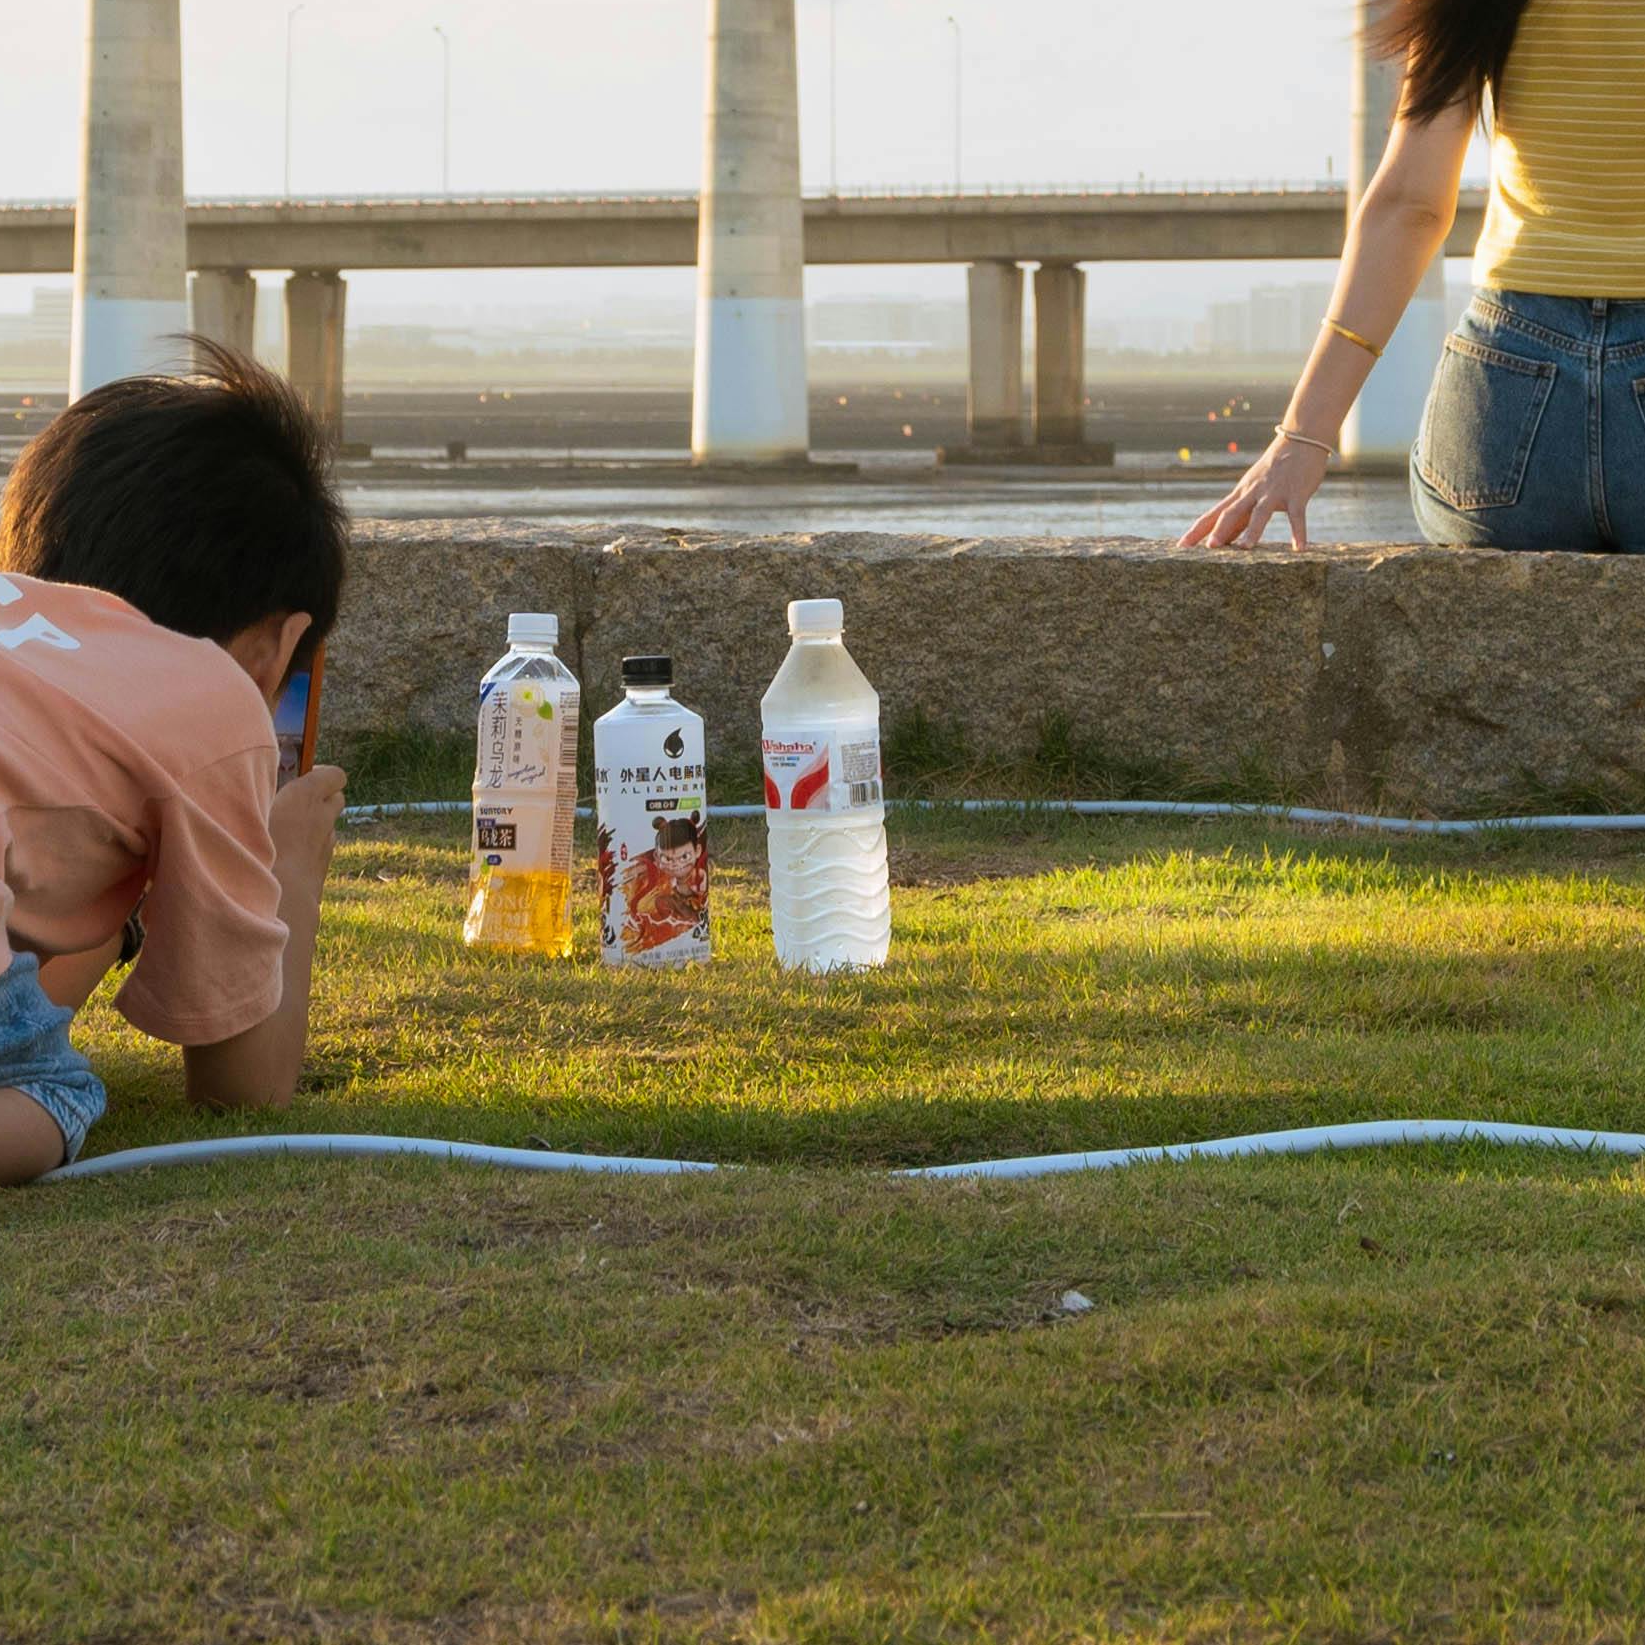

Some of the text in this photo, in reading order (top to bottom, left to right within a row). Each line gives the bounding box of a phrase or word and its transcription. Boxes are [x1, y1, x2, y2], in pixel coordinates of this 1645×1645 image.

[486, 691, 508, 789] 茉莉乌龙
[480, 807, 513, 815] SUNTORY
[480, 828, 513, 847] 乌龙茶
